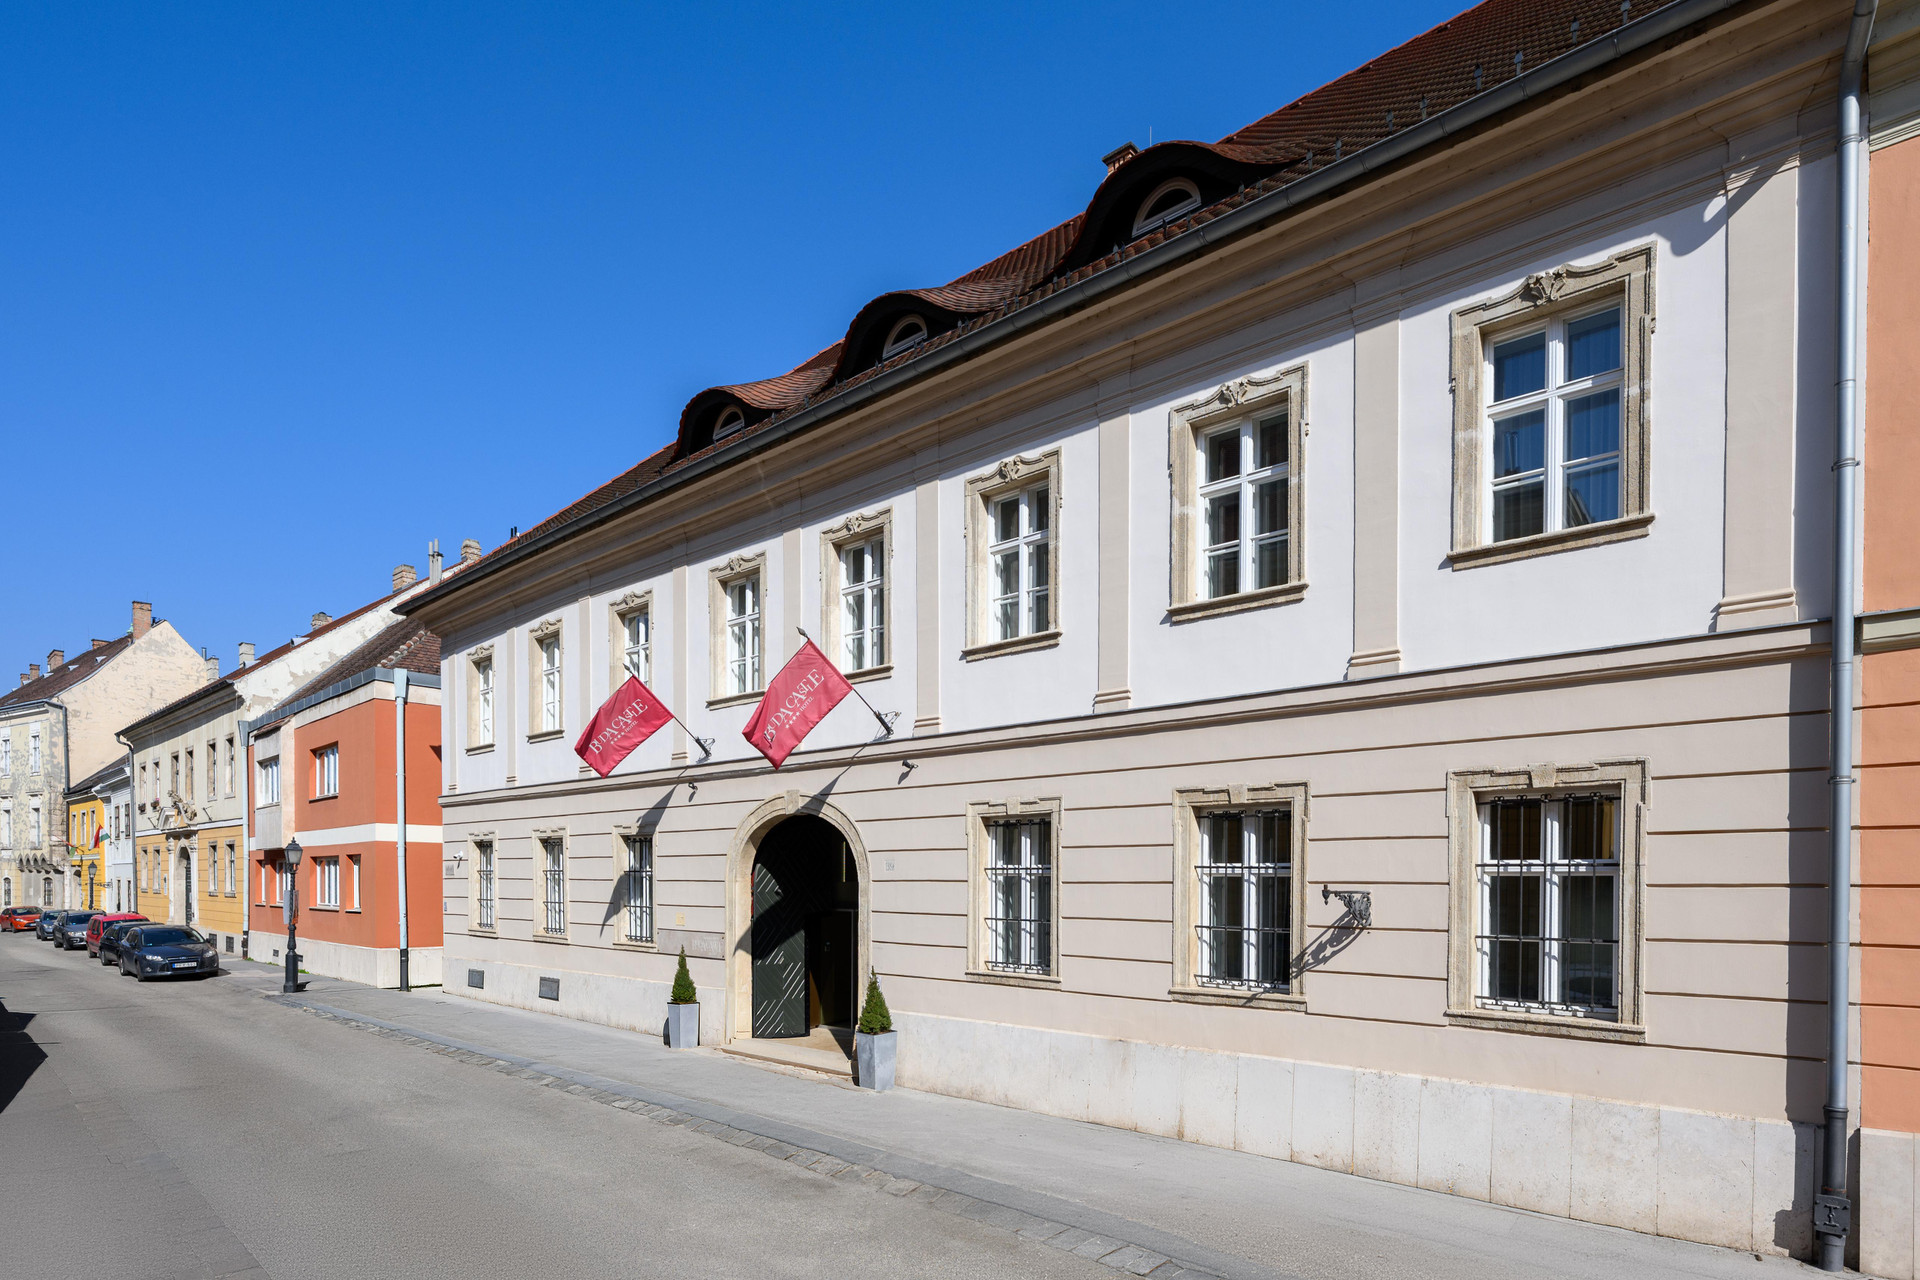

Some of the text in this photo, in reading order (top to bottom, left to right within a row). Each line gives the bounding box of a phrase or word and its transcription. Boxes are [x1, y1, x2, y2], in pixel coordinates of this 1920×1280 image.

[764, 669, 824, 742] BUDA CASTLE
[800, 696, 814, 712] HOTEL
[589, 699, 648, 755] BUDA CASTLE
[625, 720, 638, 732] HOTEL
